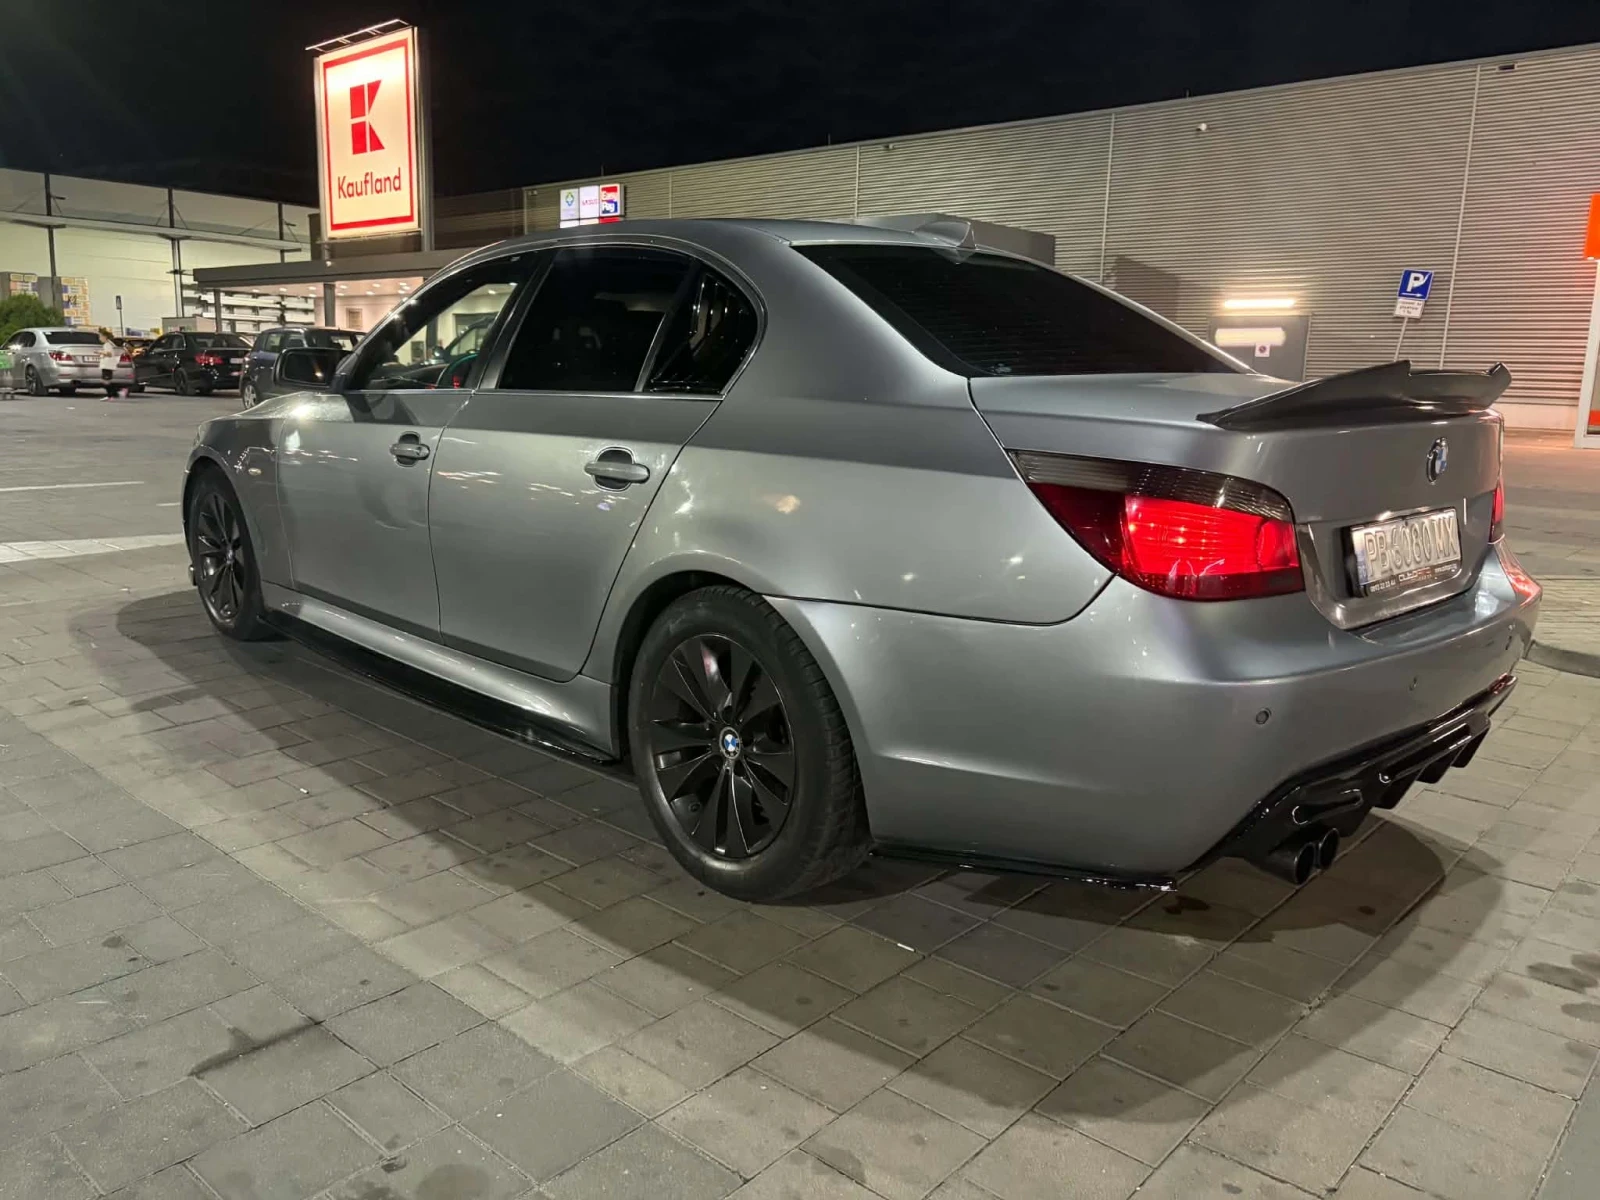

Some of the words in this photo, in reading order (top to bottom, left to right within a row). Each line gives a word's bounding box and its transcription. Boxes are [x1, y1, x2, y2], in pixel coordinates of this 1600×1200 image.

[350, 79, 385, 155] K
[338, 167, 401, 199] Kaufland
[1406, 272, 1425, 292] P
